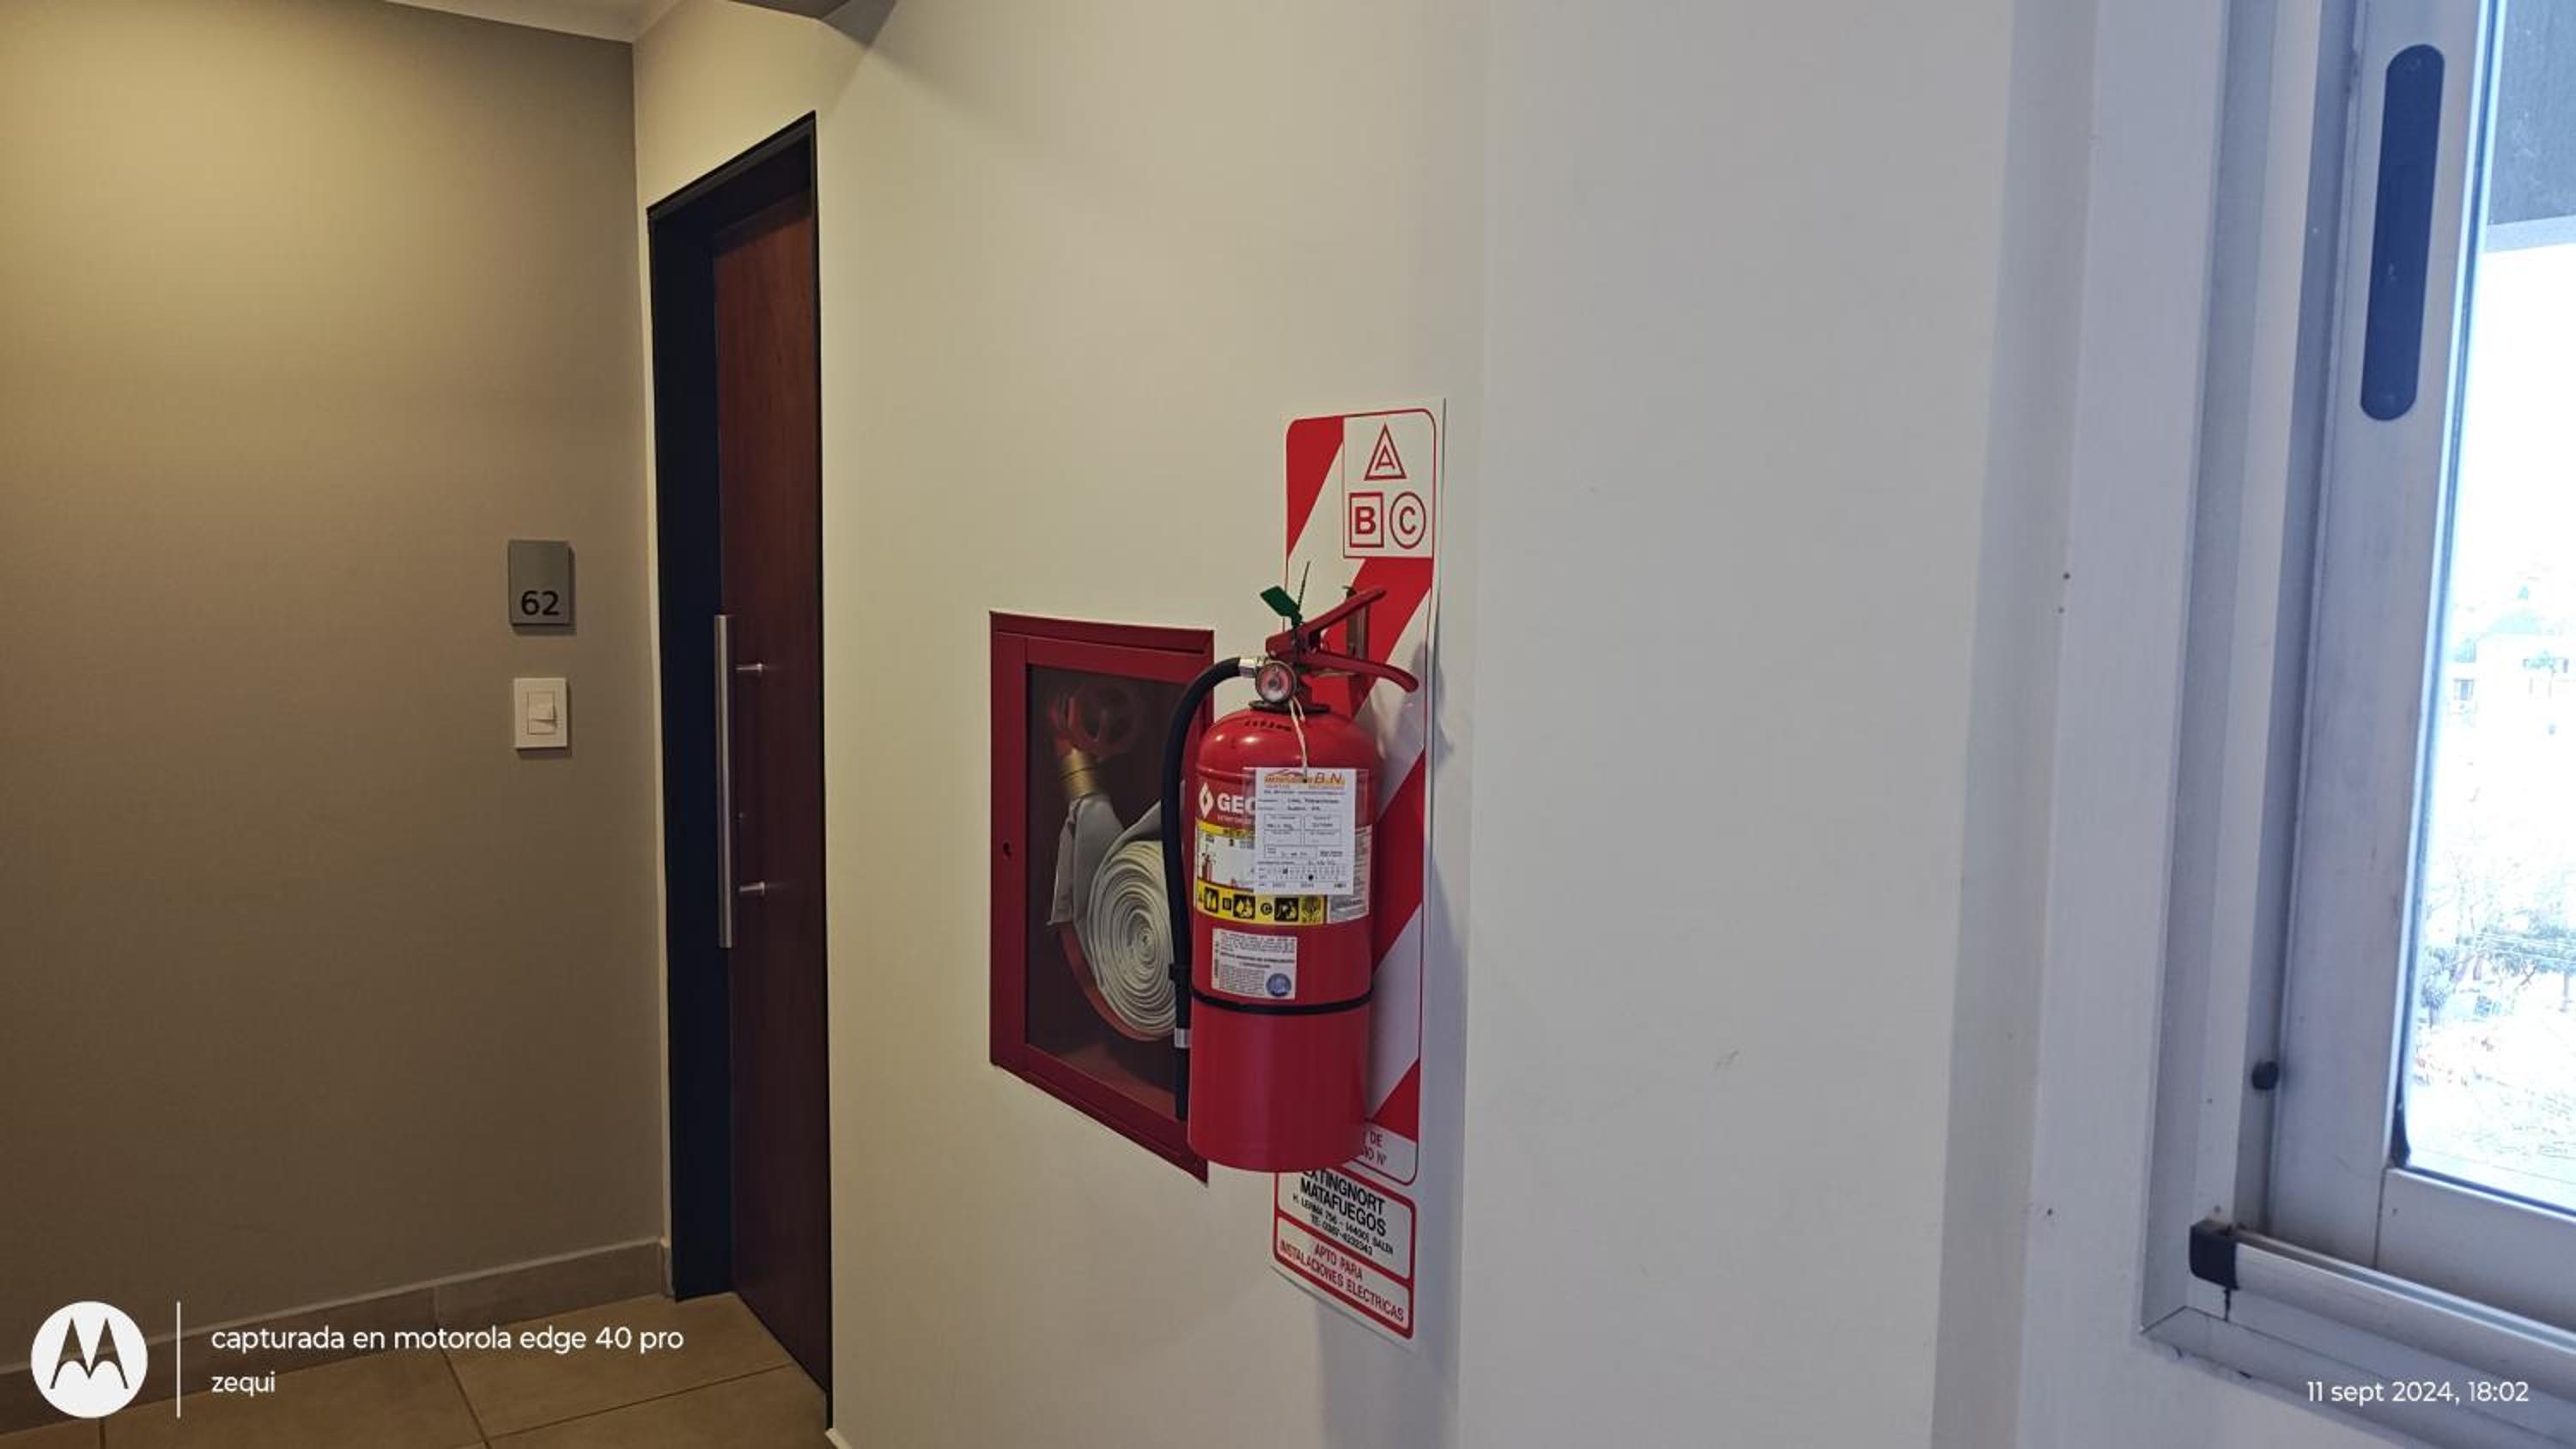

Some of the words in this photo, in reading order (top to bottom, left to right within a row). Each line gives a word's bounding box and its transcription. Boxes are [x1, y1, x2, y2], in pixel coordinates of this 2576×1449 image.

[1376, 445, 1396, 471] A
[1355, 506, 1376, 535] B
[1399, 506, 1417, 535] C
[521, 590, 560, 615] 62
[1370, 1131, 1383, 1148] DE
[1300, 1177, 1387, 1237] MATAFUEGOS
[1315, 1243, 1337, 1267] APTO
[1340, 1256, 1363, 1282] PARA
[1280, 1240, 1345, 1287] INSTALACIONES
[1346, 1278, 1405, 1323] ELECTRICAS
